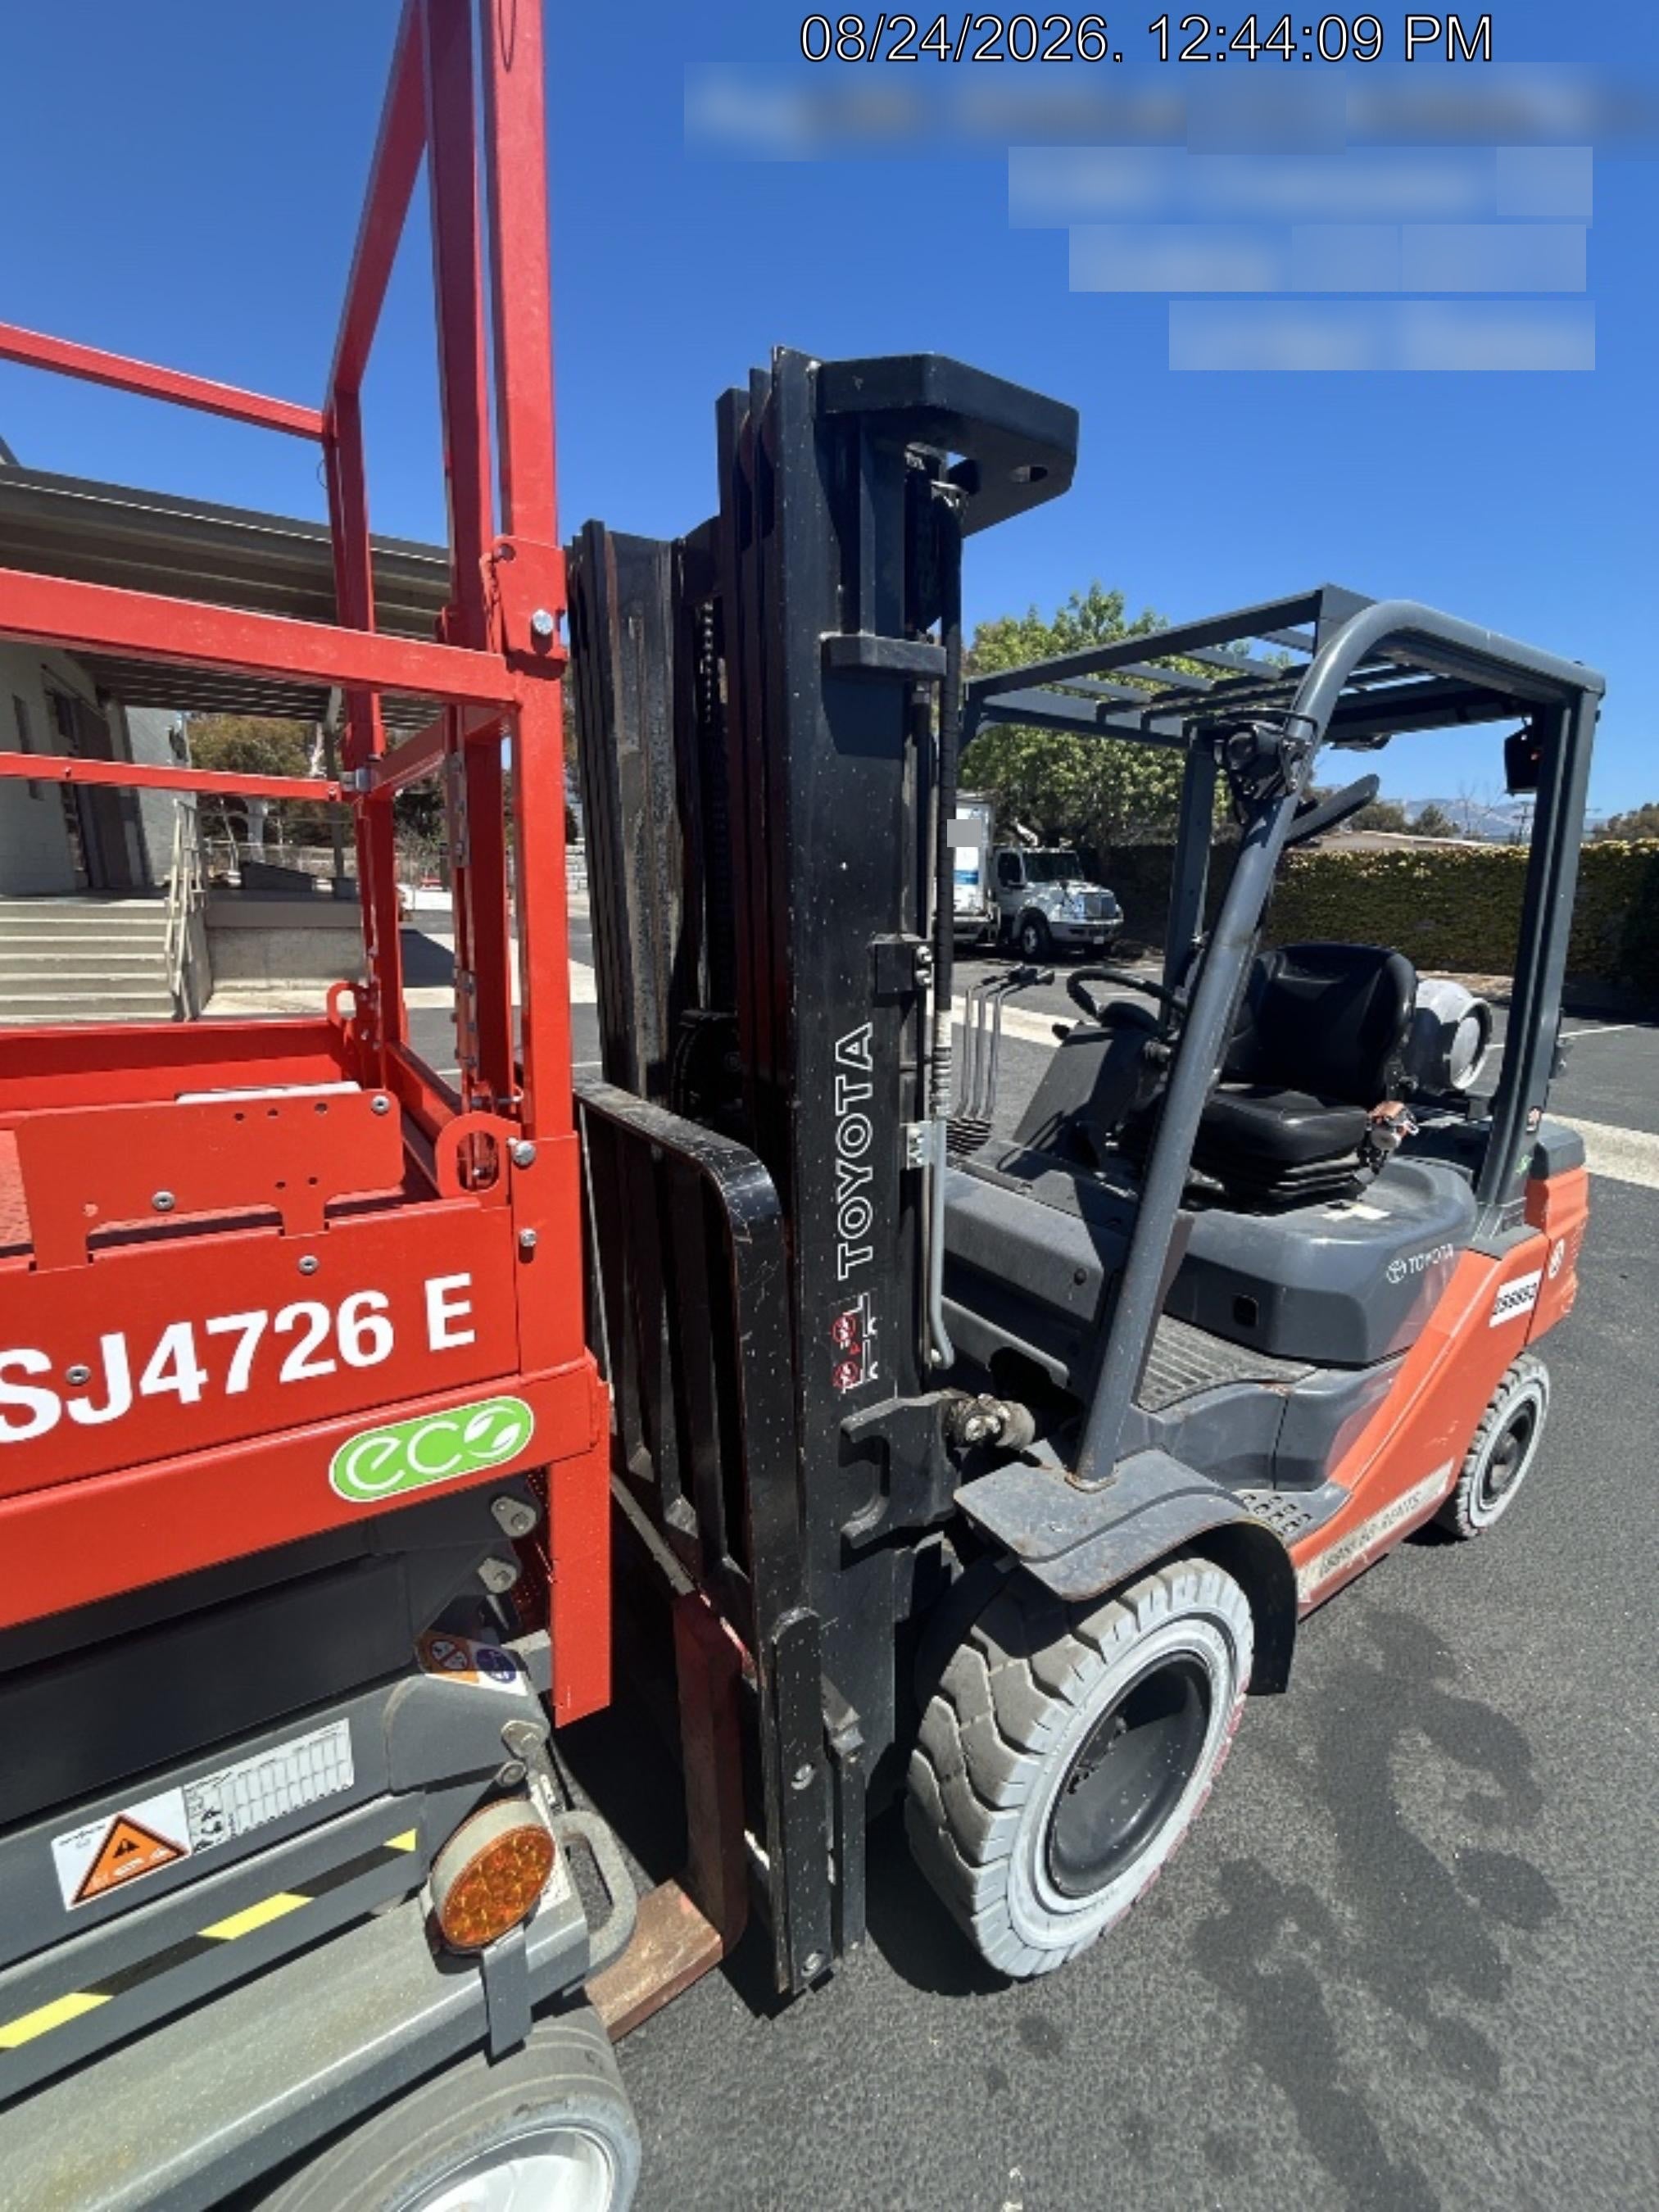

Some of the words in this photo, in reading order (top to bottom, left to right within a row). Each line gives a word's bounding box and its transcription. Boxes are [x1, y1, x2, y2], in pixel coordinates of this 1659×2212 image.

[835, 1022, 873, 1281] TOYOTA
[0, 1290, 395, 1444] SJ4726
[424, 1272, 476, 1352] E
[345, 1405, 522, 1492] eco
